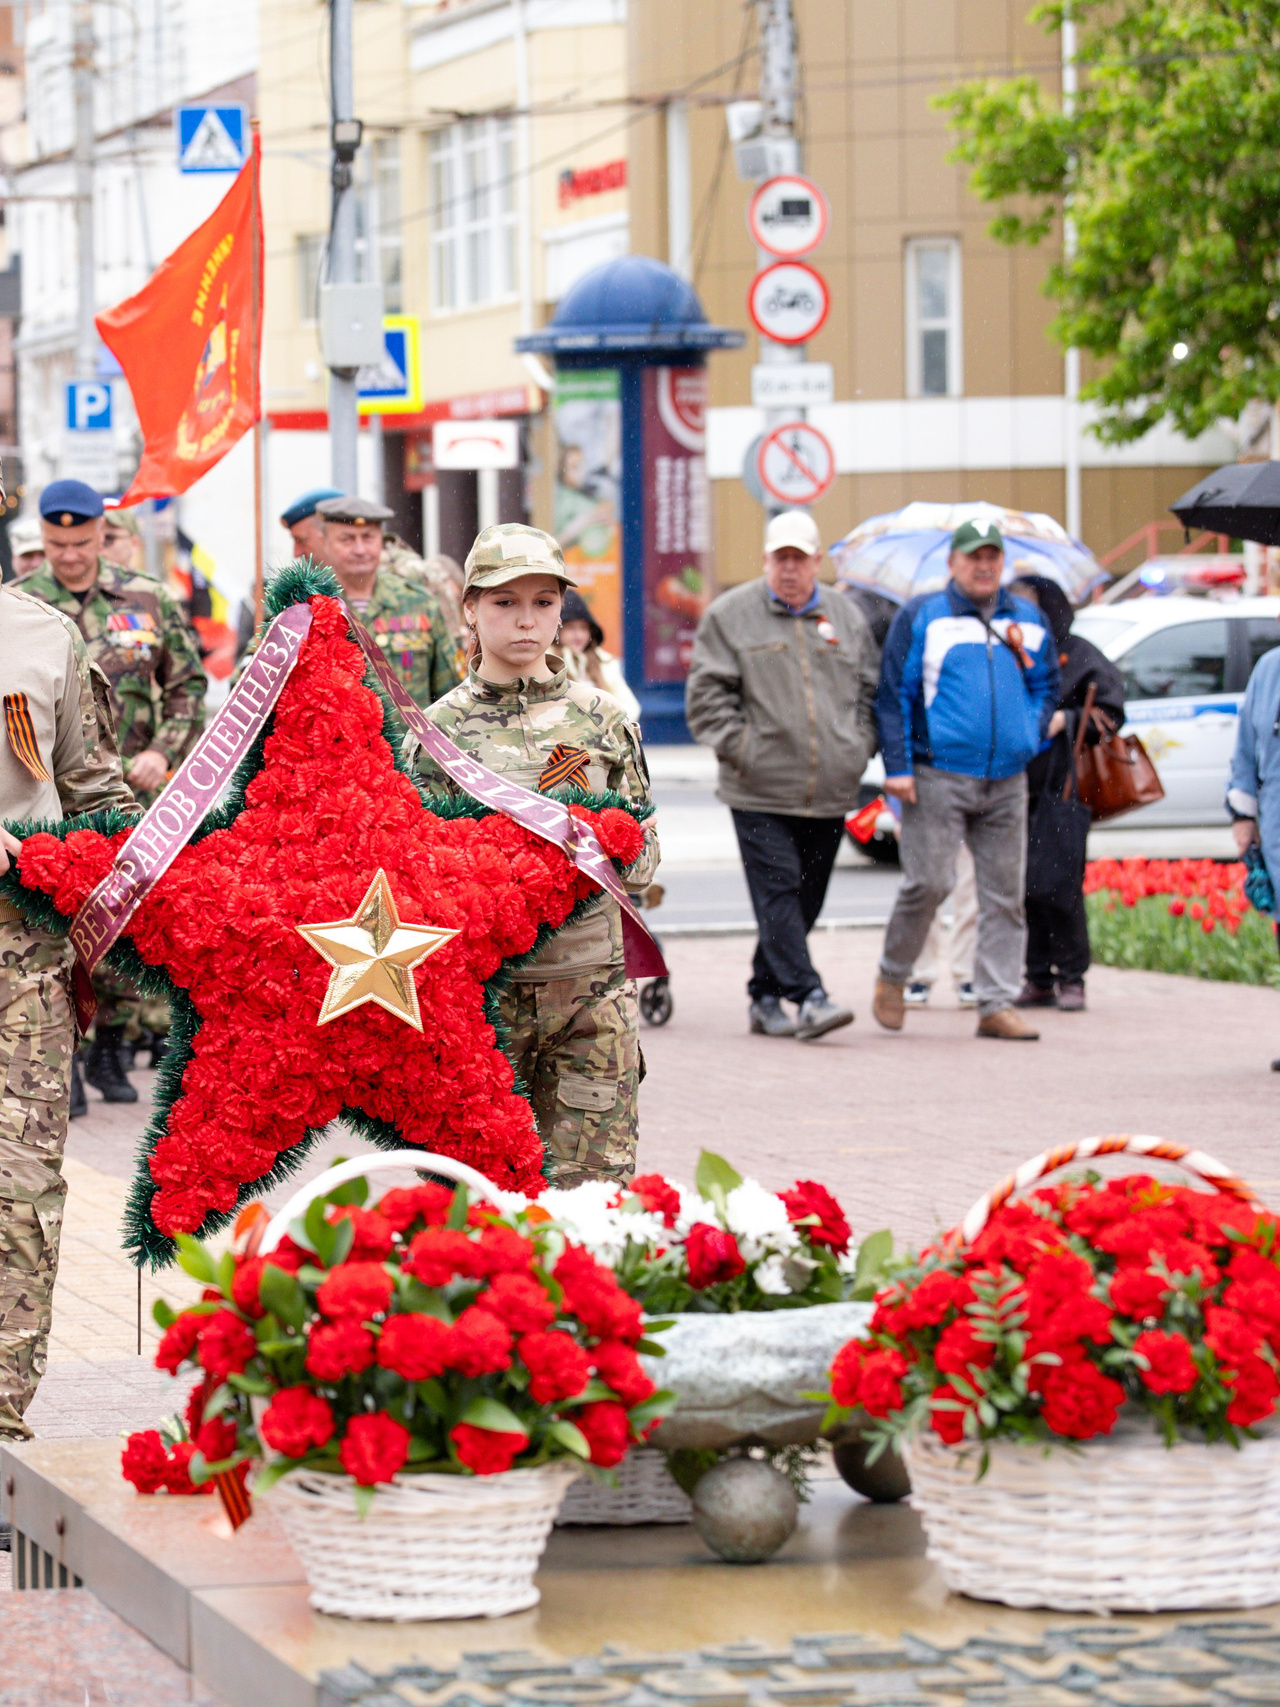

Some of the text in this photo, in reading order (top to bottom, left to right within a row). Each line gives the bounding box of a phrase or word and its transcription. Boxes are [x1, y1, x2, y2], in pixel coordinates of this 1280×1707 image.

[76, 384, 109, 429] P
[73, 623, 304, 961] ВЕТЕРАНОВ СПЕЦНАЗА
